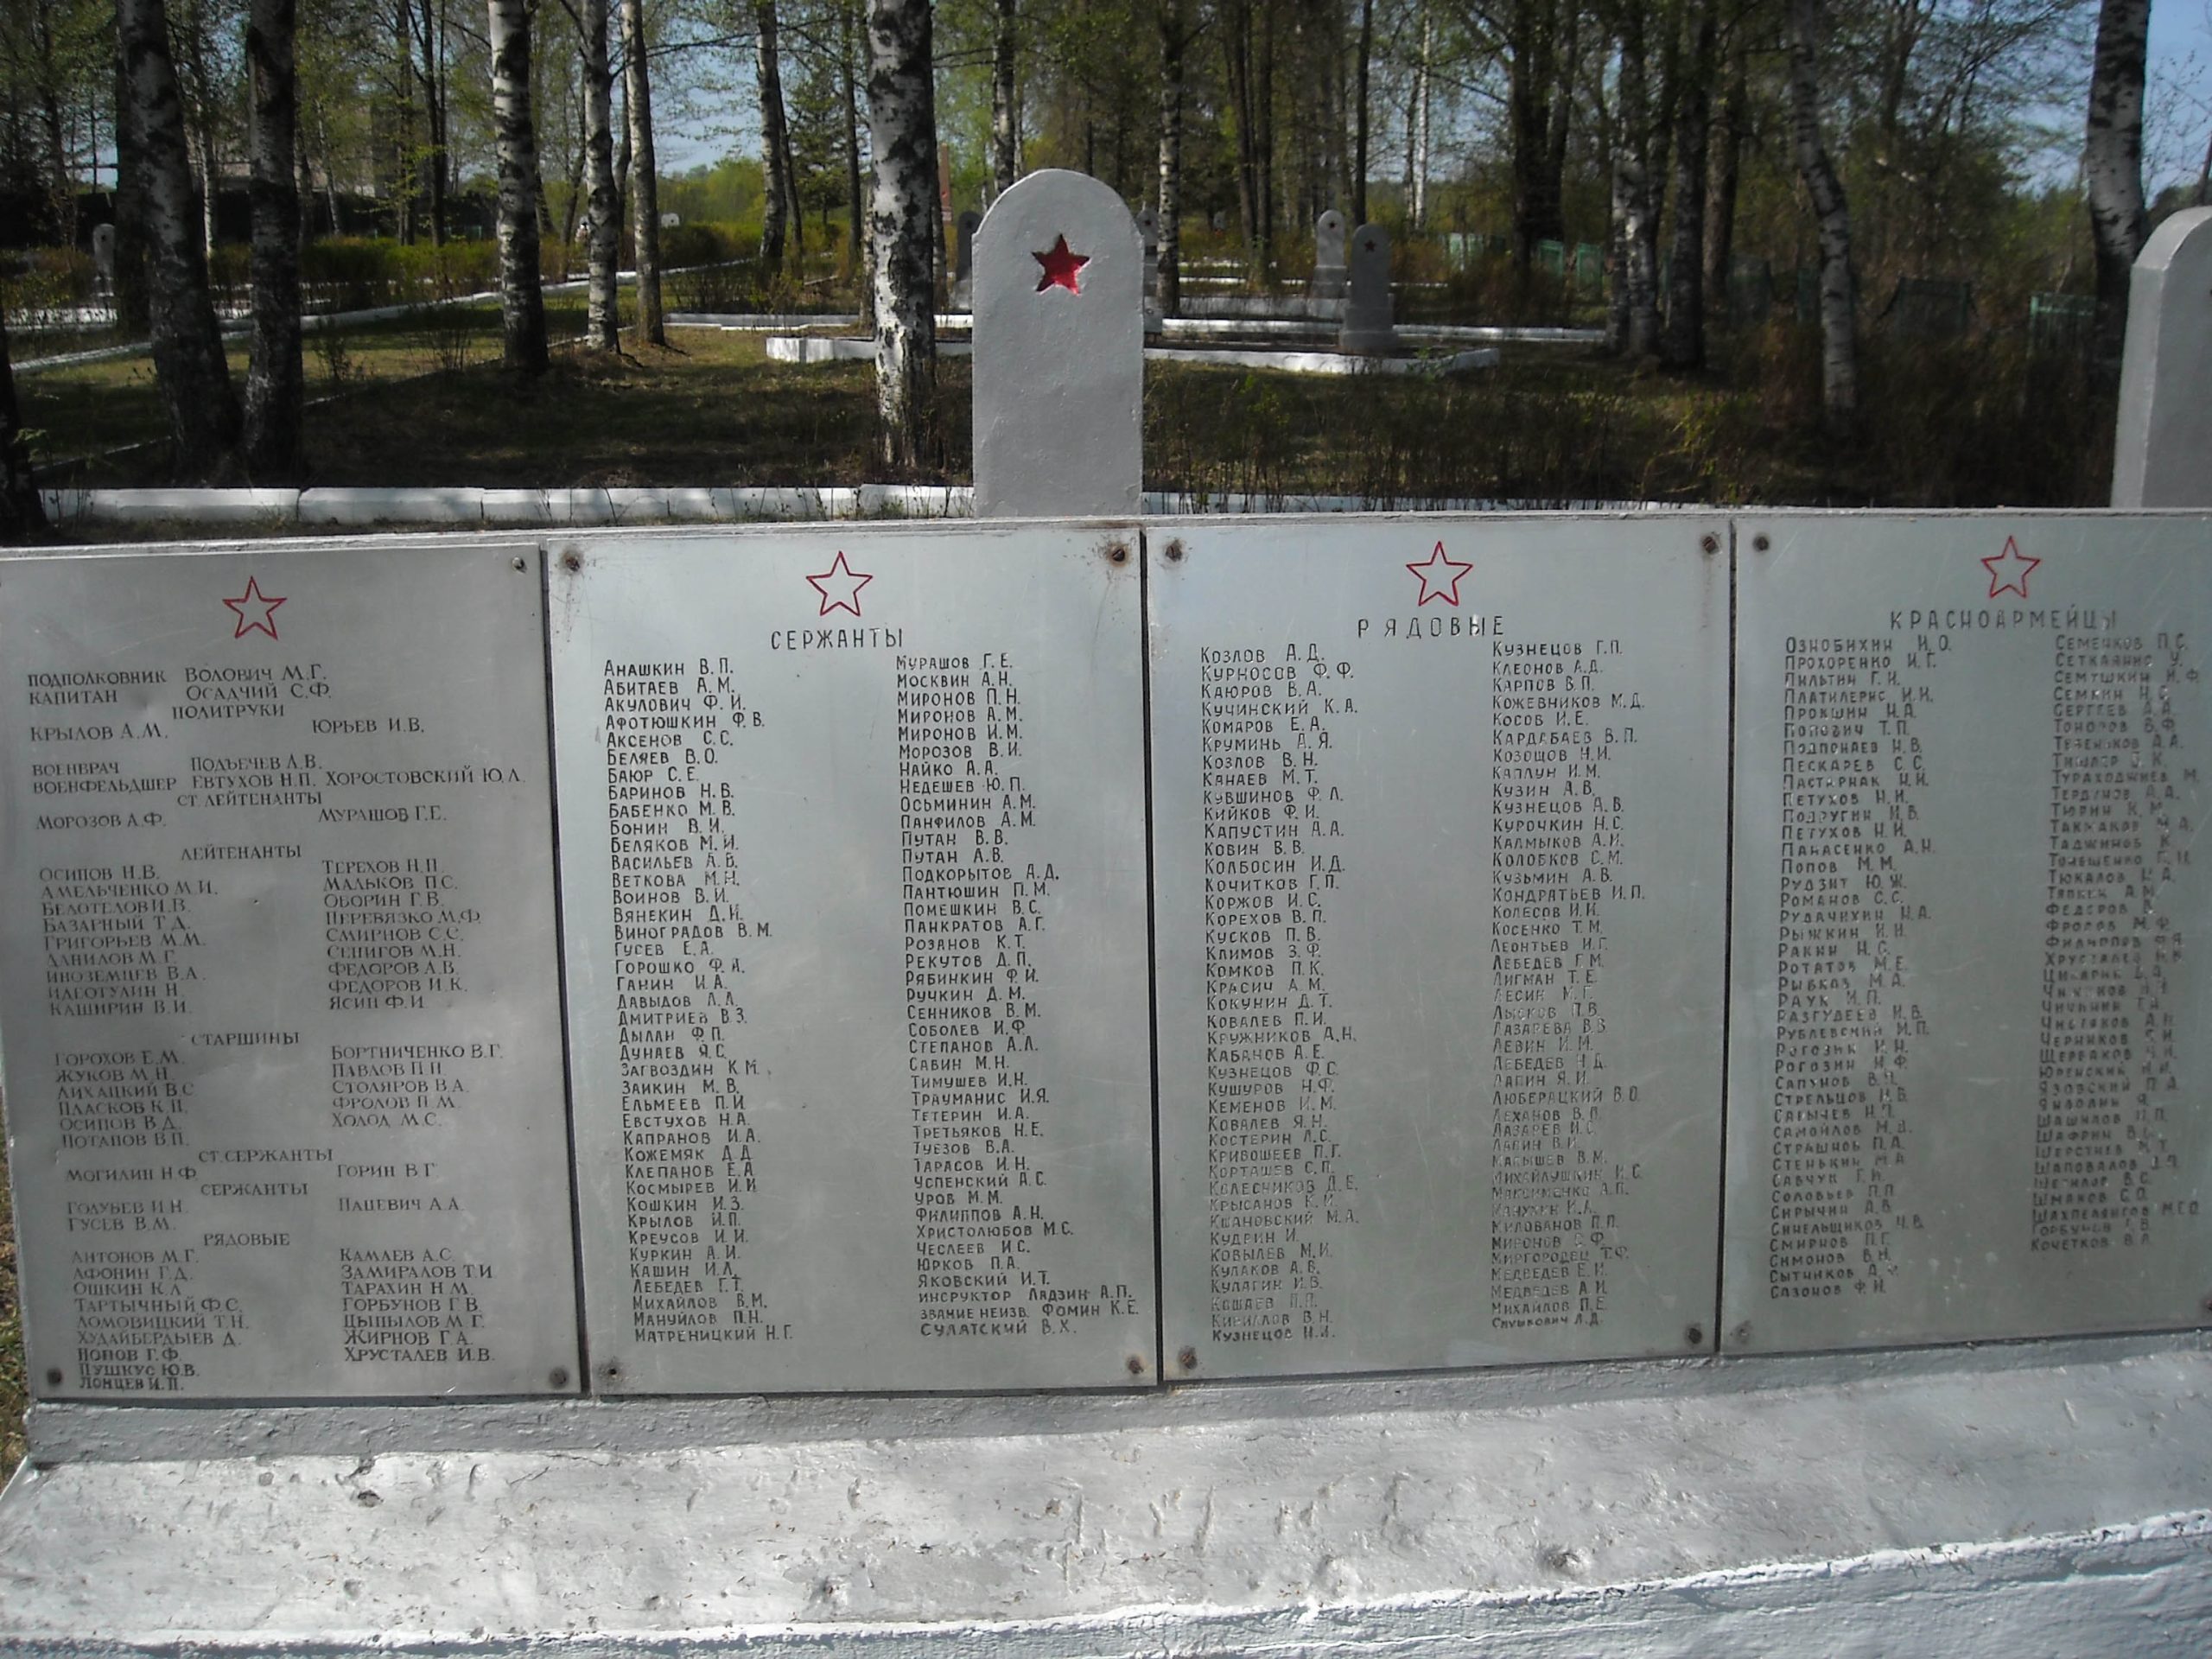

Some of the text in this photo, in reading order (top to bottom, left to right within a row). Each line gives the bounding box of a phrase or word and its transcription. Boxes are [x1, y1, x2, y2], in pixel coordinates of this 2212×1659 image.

[1358, 616, 1503, 639] РЯДОВЫЕ
[772, 628, 902, 650] СЕРЖАНТЫ
[1201, 647, 1265, 664] КОЗЛОВ
[1493, 641, 1581, 657] КУЗНЕЦОВ
[605, 660, 683, 677] АНАШКИН
[897, 655, 969, 671] МУРАШОВ
[28, 671, 166, 688] ПОДПОЛКОВНИК
[185, 667, 271, 682] ВОЛОВИЧ
[898, 674, 969, 688] МОСКВИН
[1202, 665, 1296, 682] КУРНОСОВ
[604, 679, 678, 695] АБИТАЕВ
[1202, 684, 1272, 698] КАЮРОВ
[1493, 677, 1554, 692] КАРПОВ
[29, 690, 117, 705] КАПИТАН
[605, 697, 690, 712] АКУЛОВИЧ
[898, 691, 975, 706] МИРОНОВ
[1493, 696, 1600, 709] КОЖЕВНИКОВ
[173, 704, 283, 719] ПОЛИТРУКИ
[1203, 700, 1307, 716] КУЧИНСКИЙ
[606, 715, 715, 730] АФОТЮШКИН
[899, 709, 975, 724] МИРОНОВ
[1494, 713, 1543, 726] КОСОВ
[31, 727, 113, 741] КРЫЛОВ
[313, 720, 377, 733] ЮРЬЕВ
[899, 726, 976, 741] МИРОНОВ
[1203, 719, 1273, 734] КОМАРОВ
[607, 732, 682, 747] АКСЕНОВ
[1203, 737, 1281, 753] КРУМИНЬ
[607, 748, 669, 766] БЕЛЯЕВ
[899, 744, 971, 760] МОРОЗОВ
[33, 762, 118, 776] ВОЕНВРАЧ
[899, 761, 952, 777] НАЙКО
[1204, 755, 1264, 770] КОЗЛОВ
[34, 778, 176, 794] ВОЕНФЕЛЬДШЕР
[193, 775, 273, 788] ЕВТУХОВ
[327, 766, 473, 785] ХОРОСТОВСКИЙ
[608, 768, 652, 784] БАЮР
[1204, 772, 1267, 787] КАНАЕВ
[609, 785, 685, 800] БАРИНОВ
[900, 779, 974, 795] НЕДЕШЕВ
[1494, 783, 1548, 798] КУЗИН
[901, 797, 990, 812] ОСЬМИНИН
[1204, 791, 1294, 804] КУВШИНОВ
[609, 804, 687, 818] БАБЕНКО
[1493, 800, 1581, 814] КУЗНЕЦОВ
[37, 815, 121, 830] МОРОЗОВ
[319, 808, 409, 823] МУРАШОВ
[901, 815, 985, 829] ПАНФИЛОВ
[611, 820, 667, 835] БОНИН
[1205, 823, 1297, 839] КАПУСТИН
[1494, 818, 1582, 833] КУРОЧКИН
[612, 837, 688, 853] БЕЛЯКОВ
[902, 831, 956, 847] ПУТАН
[1494, 836, 1580, 849] КАЛМЫКОВ
[181, 844, 301, 860] ЛЕЙТЕНАНТЫ
[322, 861, 399, 874] ТЕРЕХОВ
[612, 855, 692, 870] ВАСИЛЬЕВ
[1205, 858, 1294, 874] КОЛБОСИН
[40, 868, 112, 880] ОСИПОВ
[613, 873, 685, 888] ВЕТКОВА
[903, 867, 1011, 883] ПОДКОРЫТОВ
[42, 883, 168, 899] АМЕЛЬЧЕНКО
[324, 877, 413, 892] МАЛЬКОВ
[904, 885, 998, 899] ПАНТЮШИН
[1205, 877, 1297, 892] КОЧИТКОВ
[613, 889, 680, 905] ВОИНОВ
[1205, 894, 1273, 910] КОРЖОВ
[1493, 887, 1600, 904] КОНДРАТЬЕВ
[905, 902, 995, 916] ПОМЕШКИН
[43, 915, 143, 933] БАЗАРНЫЙ
[327, 912, 432, 925] ПЕРЕВЯЗКО
[906, 918, 1002, 933] ПАНКРАТОВ
[1206, 912, 1281, 926] КОРЕХОВ
[327, 928, 421, 942] СМИРНОВ
[615, 925, 723, 940] ВИНОГРАДОВ
[1493, 922, 1560, 936] КОСЕНКО
[44, 935, 151, 950] ГРИГОРЬЕВ
[906, 937, 979, 950] РОЗАНОВ
[1206, 946, 1274, 960] КЛИМОВ
[616, 960, 694, 975] ГОРОШКО
[906, 954, 982, 969] РЕКУТОВ
[48, 969, 157, 983] ИНОЗЕМЦЕВ
[328, 962, 419, 977] ФЕДОРОВ
[906, 970, 992, 986] РЯБИНКИН
[328, 980, 421, 995] ФЕДОРОВ
[51, 1002, 143, 1016] КАШИРИН
[330, 996, 378, 1009] ЯСИН
[907, 1005, 991, 1020] СЕННИКОВ
[1208, 1014, 1281, 1028] КОВАЛЕВ
[192, 1032, 298, 1046] СТАРШИНЫ
[910, 1039, 993, 1053] СТЕПАНОВ
[55, 1052, 135, 1066] ГОРОХОВ
[332, 1046, 465, 1059] БОРТНИЧЕНКО
[620, 1045, 684, 1061] ДУНАЕВ
[1208, 1047, 1284, 1063] КАБАНОВ
[55, 1070, 124, 1083] ЖУКОВ
[333, 1063, 404, 1077] ПАВЛОВ
[1209, 1065, 1292, 1079] КУЗНЕЦОВ
[333, 1081, 428, 1093] СТОЛЯРОВ
[333, 1096, 410, 1109] ФРОЛОВ
[1210, 1099, 1285, 1114] КЕМЕНОВ
[623, 1114, 706, 1128] ЕВСТУХОВ
[912, 1109, 981, 1122] ТЕТЕРИН
[624, 1130, 710, 1145] КАПРАНОВ
[912, 1126, 1001, 1139] ТРЕТЬЯКОВ
[1209, 1148, 1300, 1163] КРИВОШЕЕВ
[67, 1169, 153, 1182] МОГИЛИН
[338, 1165, 394, 1178] ГОРИН
[626, 1164, 714, 1179] КЛЕПАНОВ
[626, 1180, 715, 1195] КОСМЫРЕВ
[914, 1173, 1007, 1189] УСПЕНСКИЙ
[201, 1183, 308, 1196] СЕРЖАНТЫ
[68, 1217, 124, 1231] ГУСЕВ
[917, 1224, 1032, 1239] ХРИСТОЛЮБОВ
[204, 1233, 289, 1247] РЯДОВЫЕ
[1211, 1232, 1274, 1246] КУДРИН
[73, 1251, 155, 1263] АНТОНОВ
[630, 1247, 691, 1262] КУРКИН
[73, 1268, 148, 1279] АФОНИН
[341, 1265, 456, 1279] ЗАМИРАЛОВ
[918, 1271, 1007, 1287] ЯКОВСКИЙ
[341, 1281, 421, 1294] ТАРАХИН
[74, 1296, 194, 1313] ТАРТЫЧНЫЙ
[343, 1297, 441, 1312] ГОРБУНОВ
[633, 1294, 717, 1310] МИХАЙЛОВ
[345, 1330, 429, 1345] ЖИРНОВ
[635, 1326, 755, 1343] МАТРЕНИЦКИЙ
[345, 1347, 447, 1362] ХРУСТАЛЕВ
